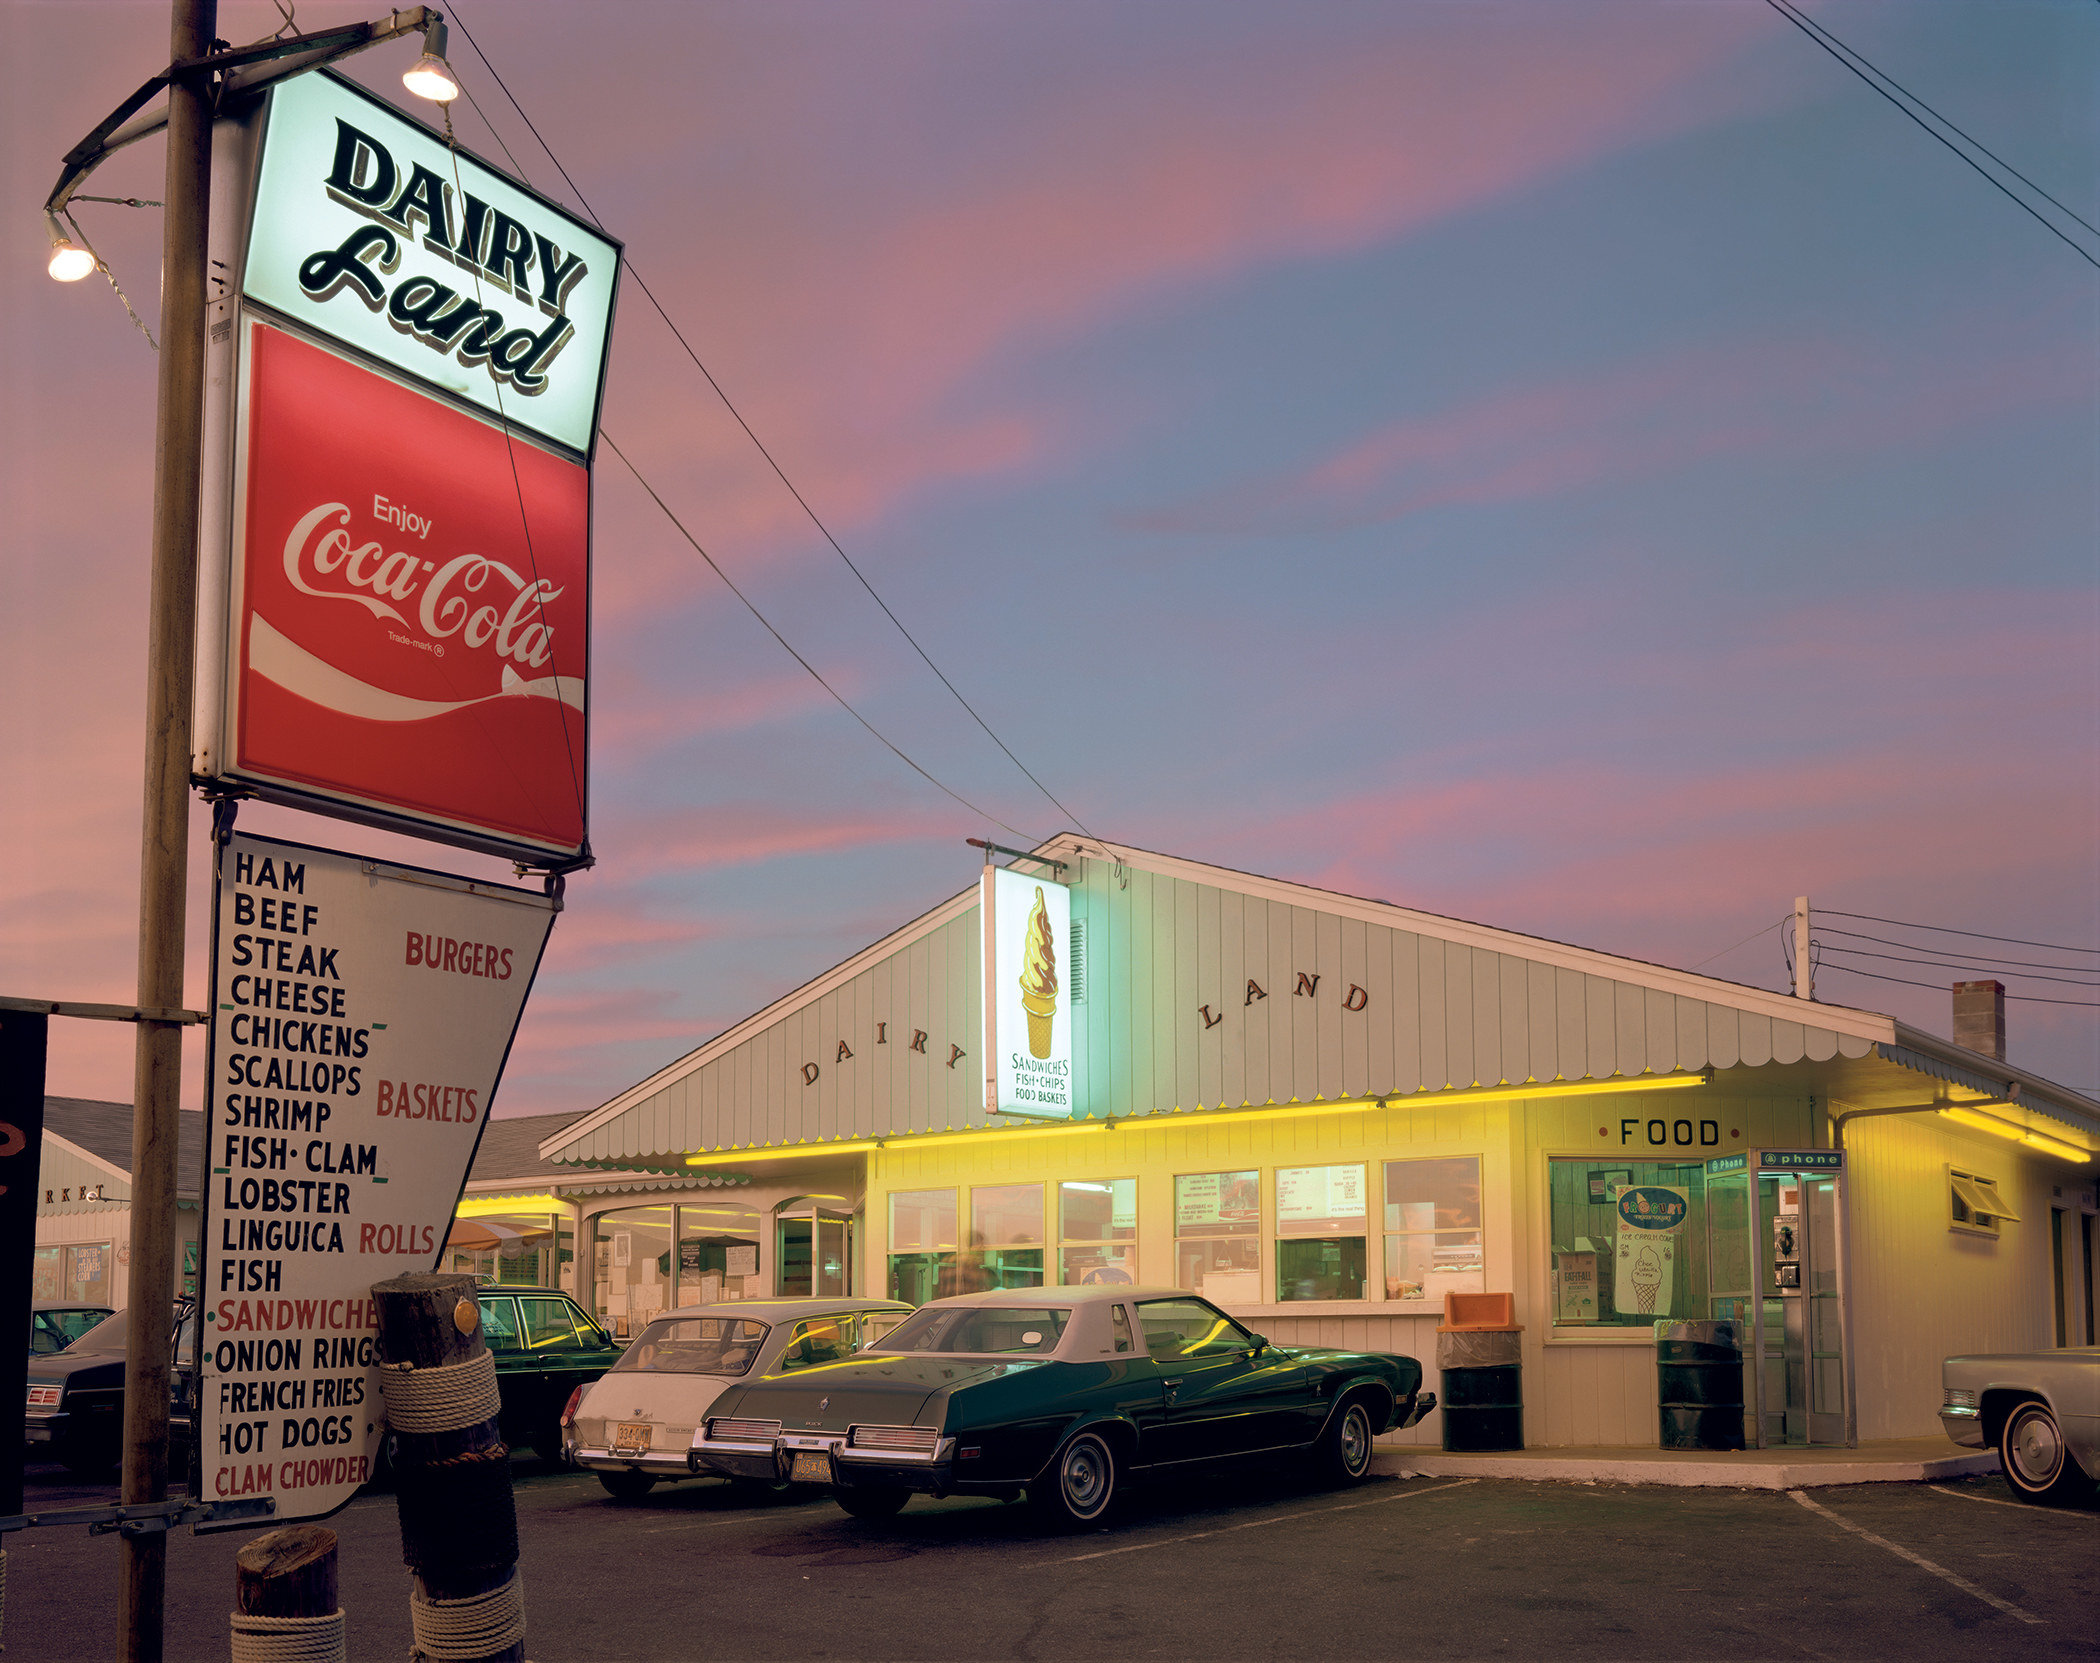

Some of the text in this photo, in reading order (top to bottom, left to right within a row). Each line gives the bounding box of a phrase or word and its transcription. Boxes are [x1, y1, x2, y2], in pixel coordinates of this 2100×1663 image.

[324, 116, 588, 317] DAIRY
[298, 224, 576, 397] Land
[374, 493, 432, 540] Enjoy
[283, 501, 566, 669] Coca-Cola
[235, 852, 305, 894] HAM
[234, 892, 318, 936] BEEF
[231, 933, 340, 980] STEAK
[405, 930, 514, 980] BURGERS
[230, 974, 346, 1018] CHEESE
[230, 1013, 370, 1059] CHICKENS
[800, 971, 1368, 1087] DAIRY LAND
[227, 1053, 362, 1096] SCALLOPS
[1011, 1053, 1069, 1076] SANDWICHES
[225, 1093, 331, 1133] SHRIMP
[376, 1079, 478, 1124] BASKETS
[1015, 1088, 1067, 1106] FOOD BASKETS
[1621, 1118, 1719, 1147] FOOD
[305, 1140, 378, 1176] CLAM
[1781, 1154, 1838, 1165] phone
[45, 1184, 104, 1203] RKET
[224, 1176, 351, 1214] LOBSTER
[222, 1218, 345, 1253] LINGUICA
[359, 1222, 434, 1255] ROLLS
[220, 1259, 282, 1292] FISH
[216, 1299, 380, 1332] SANDWICHE
[215, 1336, 384, 1373] ONION RINGS
[220, 1376, 365, 1414] FRENCH FRIES
[220, 1415, 353, 1455] HOT DOGS
[215, 1455, 369, 1497] CLAM CHOWDER
